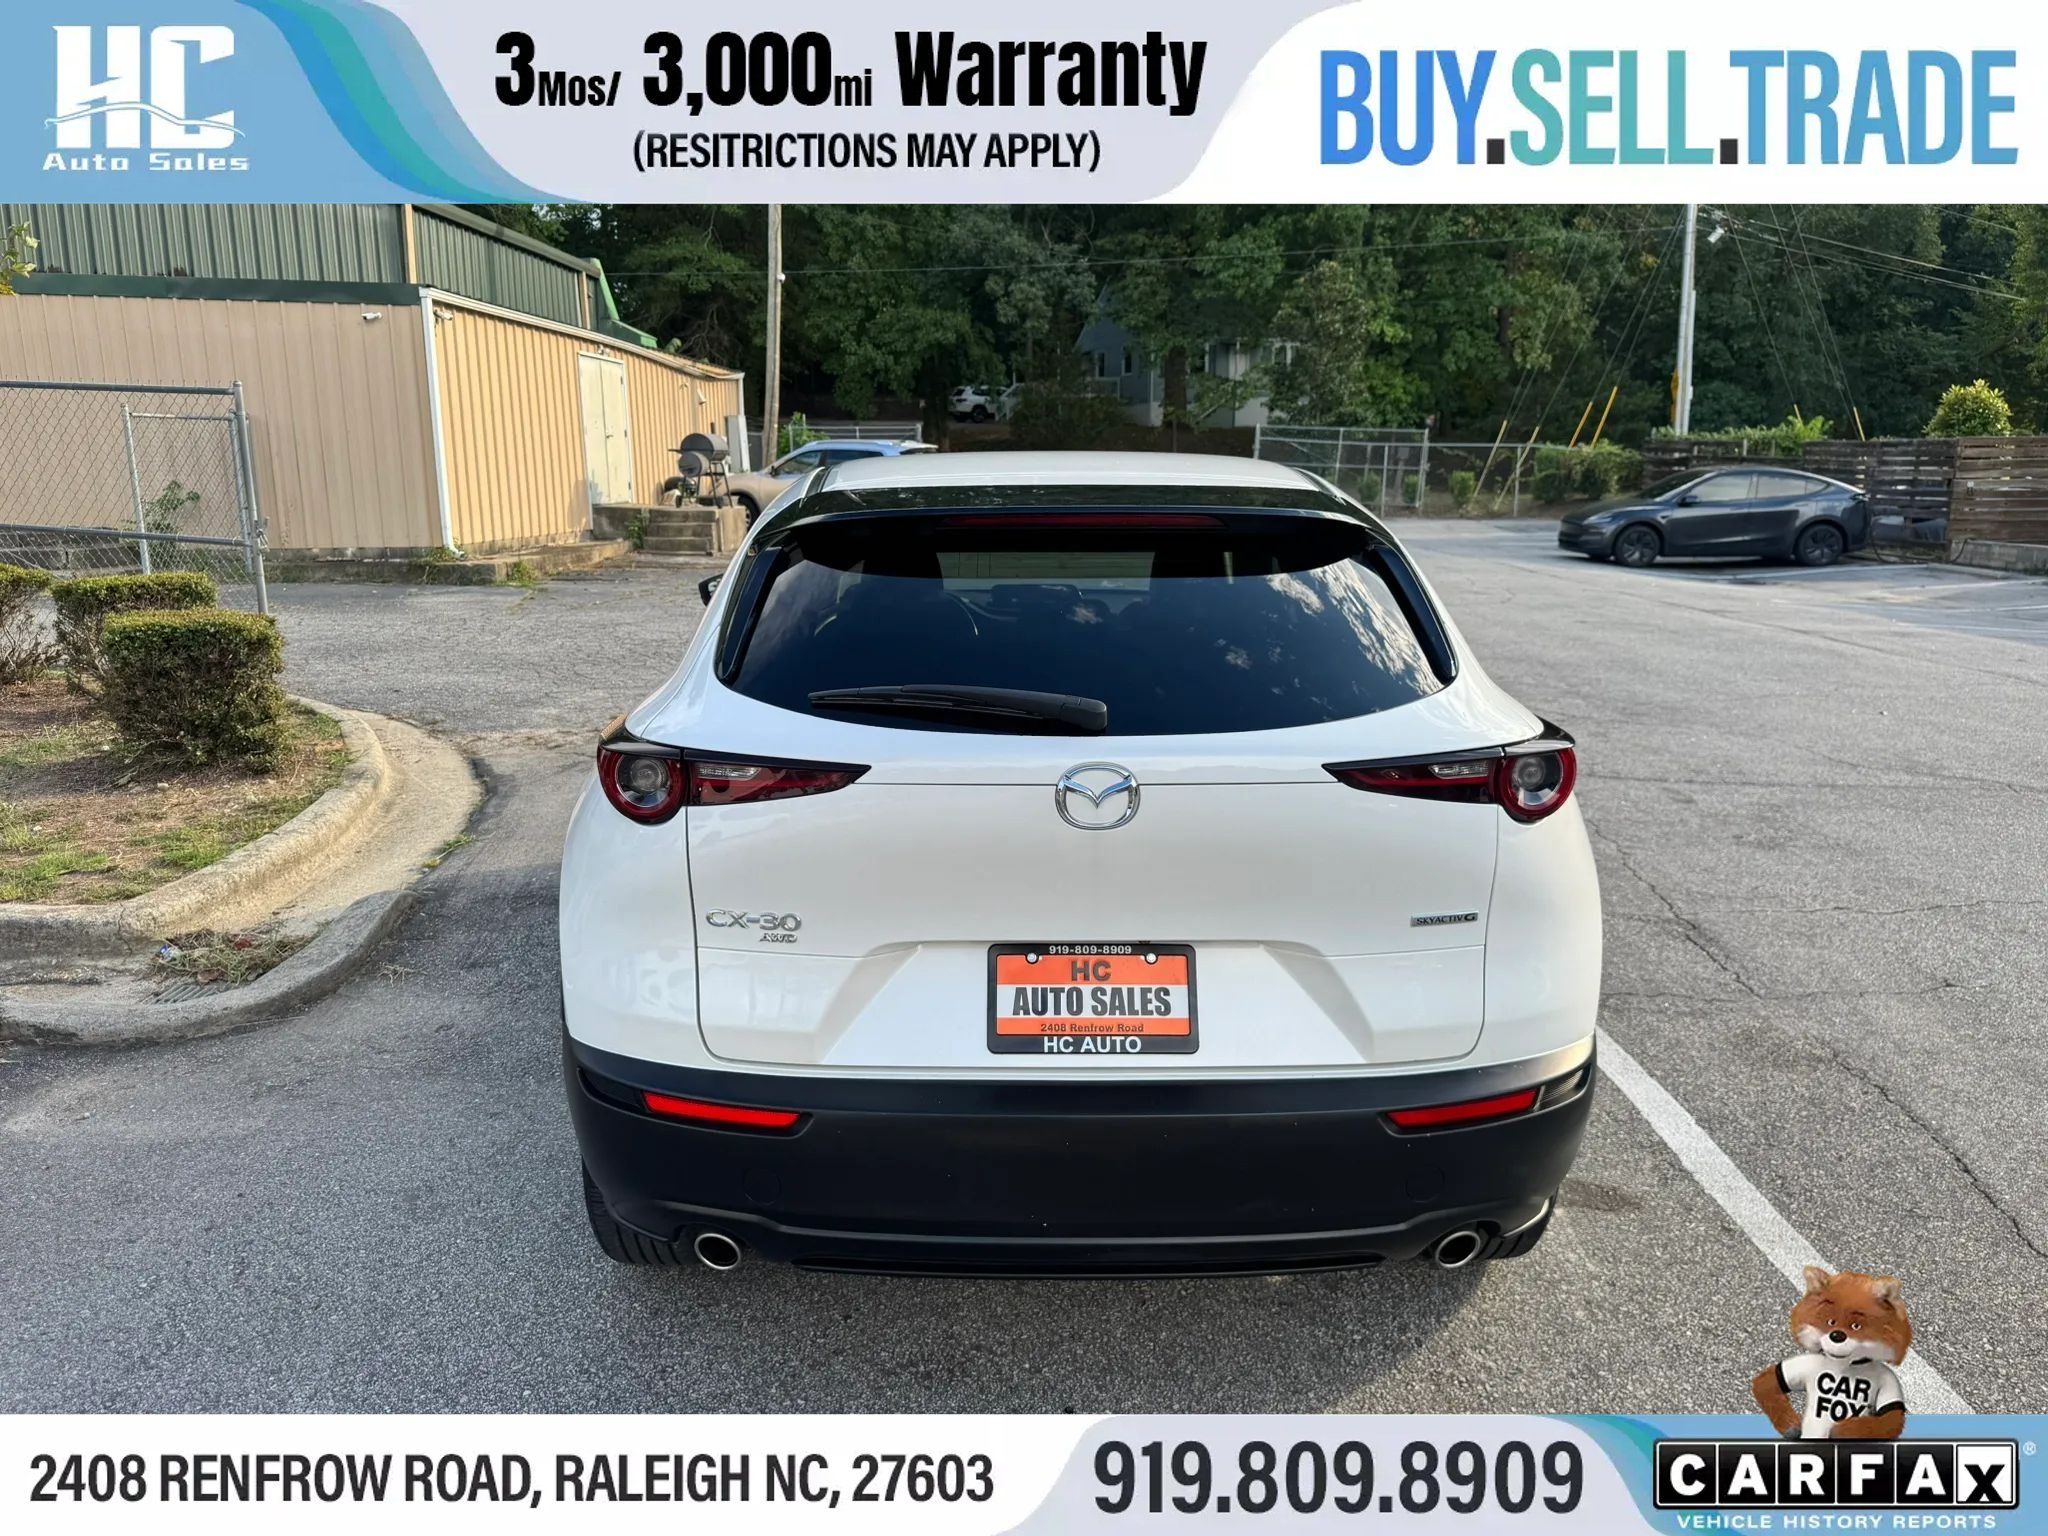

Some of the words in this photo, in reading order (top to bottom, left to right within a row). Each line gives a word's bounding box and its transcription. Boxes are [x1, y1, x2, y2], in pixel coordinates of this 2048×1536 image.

[706, 909, 802, 932] CX-30
[759, 933, 798, 943] AWD
[1049, 945, 1132, 955] 919-809-8909
[1071, 960, 1112, 981] HC
[1012, 987, 1083, 1016] AUTO
[1091, 987, 1172, 1016] SALES
[1040, 1023, 1067, 1033] 2408
[1070, 1023, 1114, 1033] Renfrow
[1117, 1023, 1144, 1033] Road
[1043, 1036, 1074, 1053] HC
[1080, 1036, 1142, 1053] AUTO
